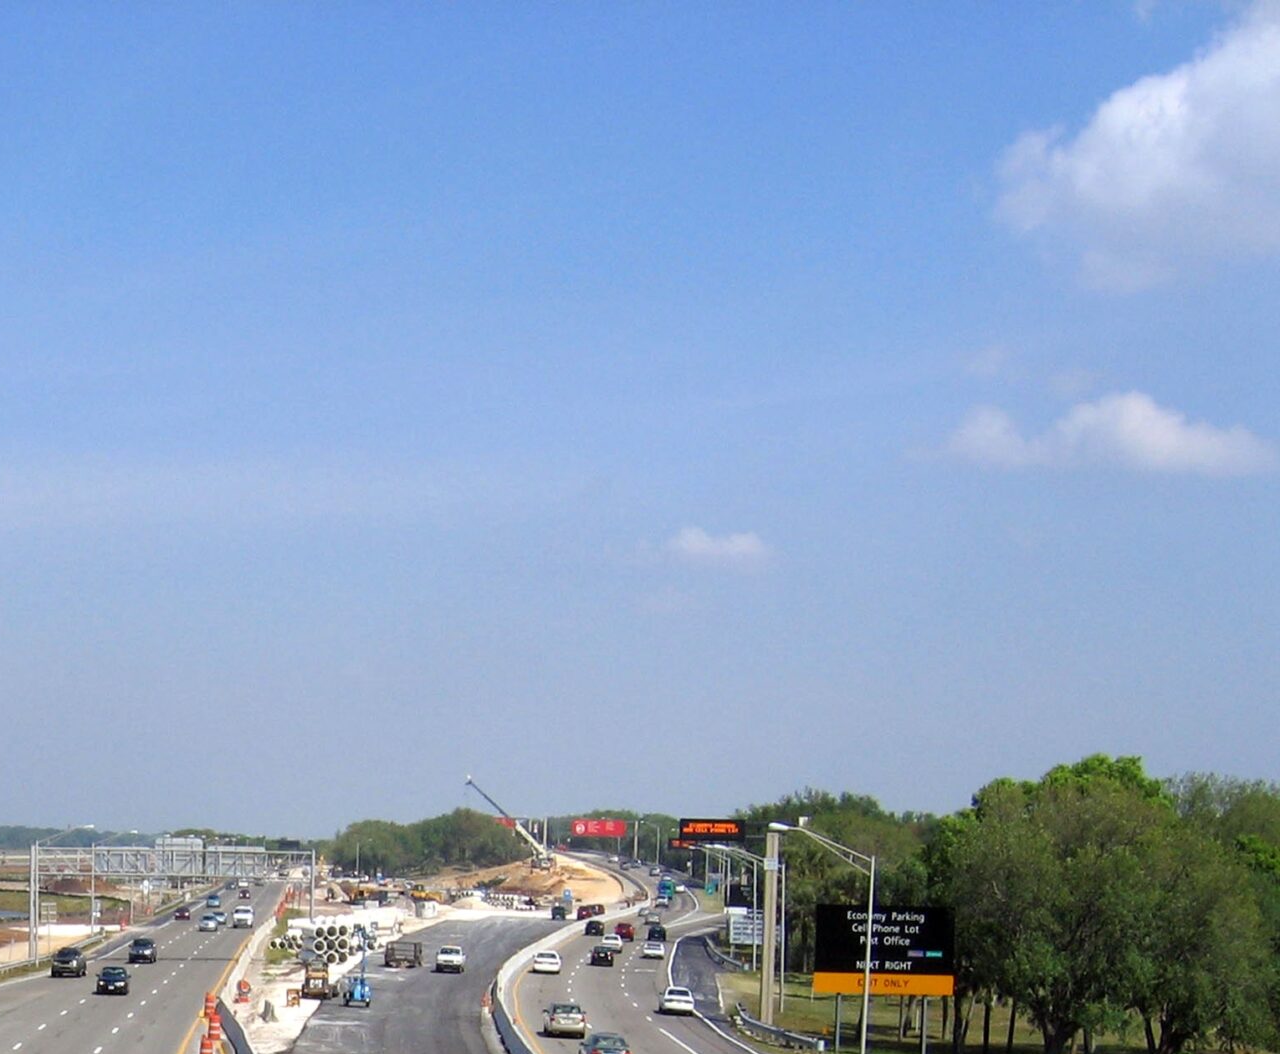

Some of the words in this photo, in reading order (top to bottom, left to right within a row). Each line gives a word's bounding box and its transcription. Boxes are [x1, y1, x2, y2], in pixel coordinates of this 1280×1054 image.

[847, 910, 887, 923] Econmy
[891, 911, 925, 924] Parking
[872, 923, 900, 933] Phone
[904, 925, 920, 934] Lot
[859, 935, 879, 946] Pst
[883, 936, 911, 947] Office
[884, 961, 912, 971] RIGHT
[857, 978, 878, 988] EIT
[883, 979, 910, 989] ONLY
